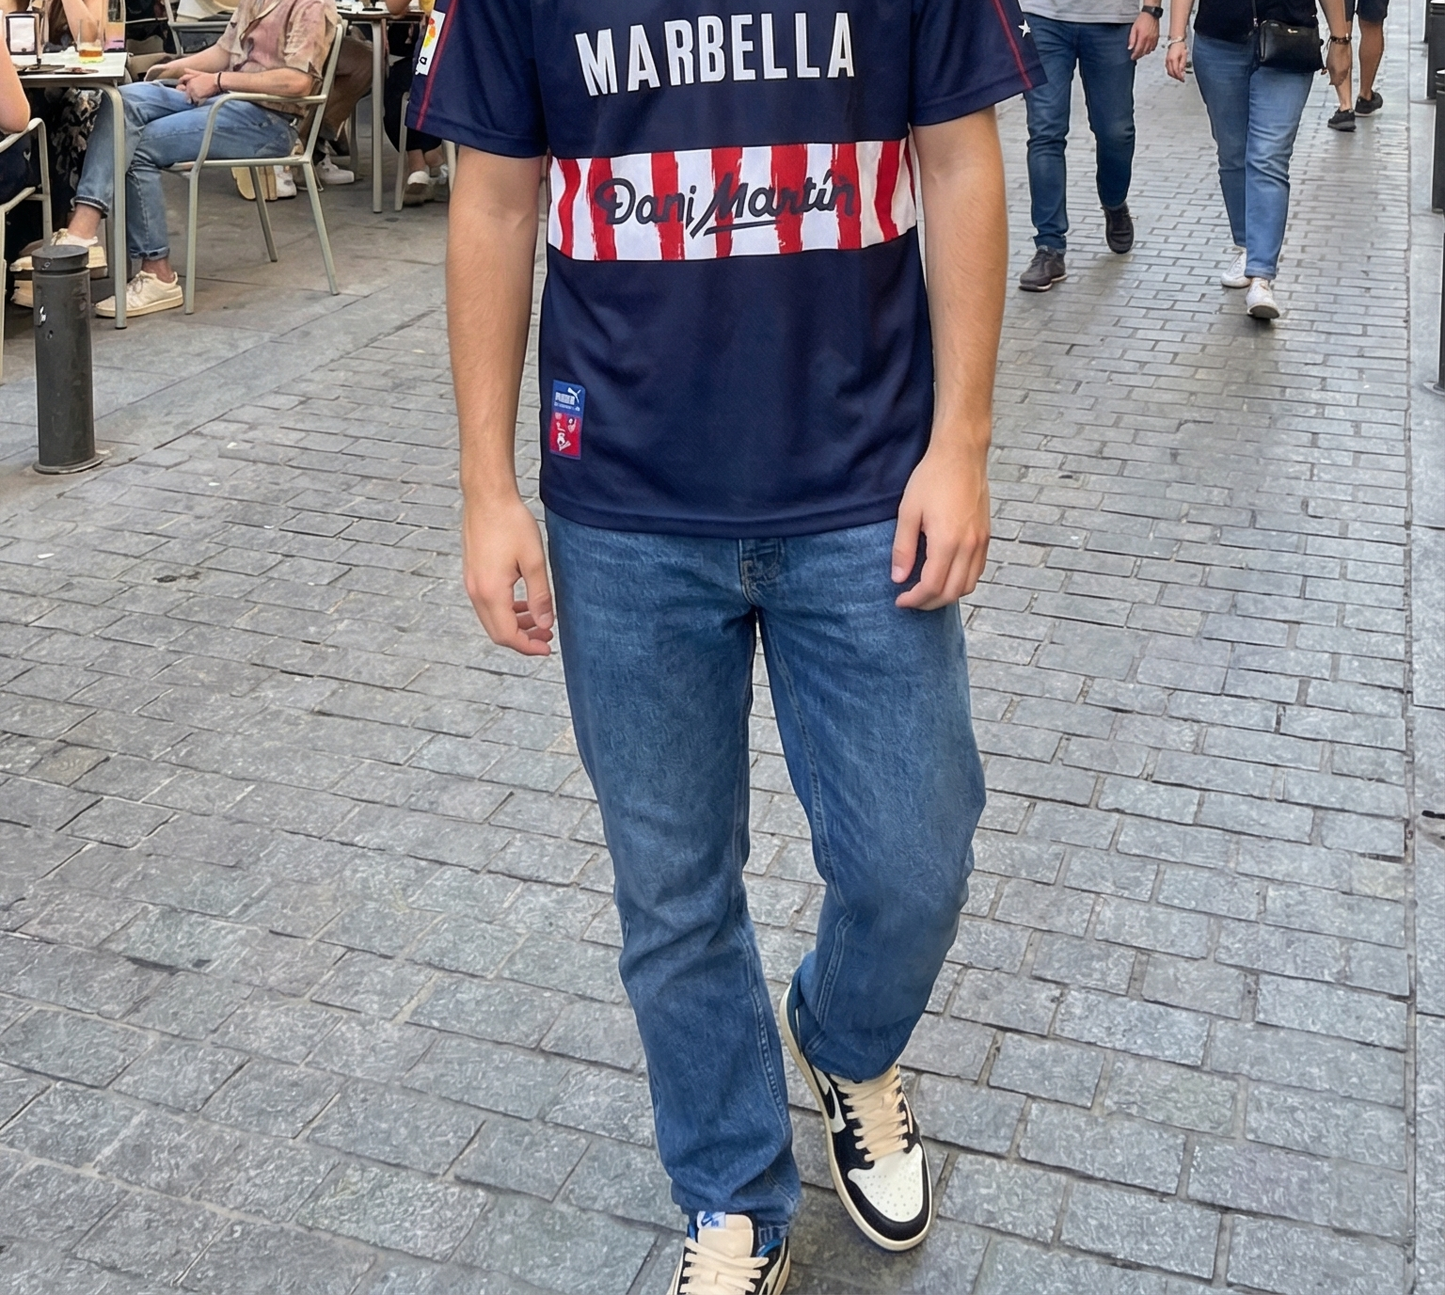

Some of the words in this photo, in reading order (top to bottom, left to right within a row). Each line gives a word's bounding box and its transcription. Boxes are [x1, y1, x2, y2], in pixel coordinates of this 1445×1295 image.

[574, 12, 855, 96] MARBELLA
[594, 177, 698, 230] Dani
[690, 170, 855, 239] Martín
